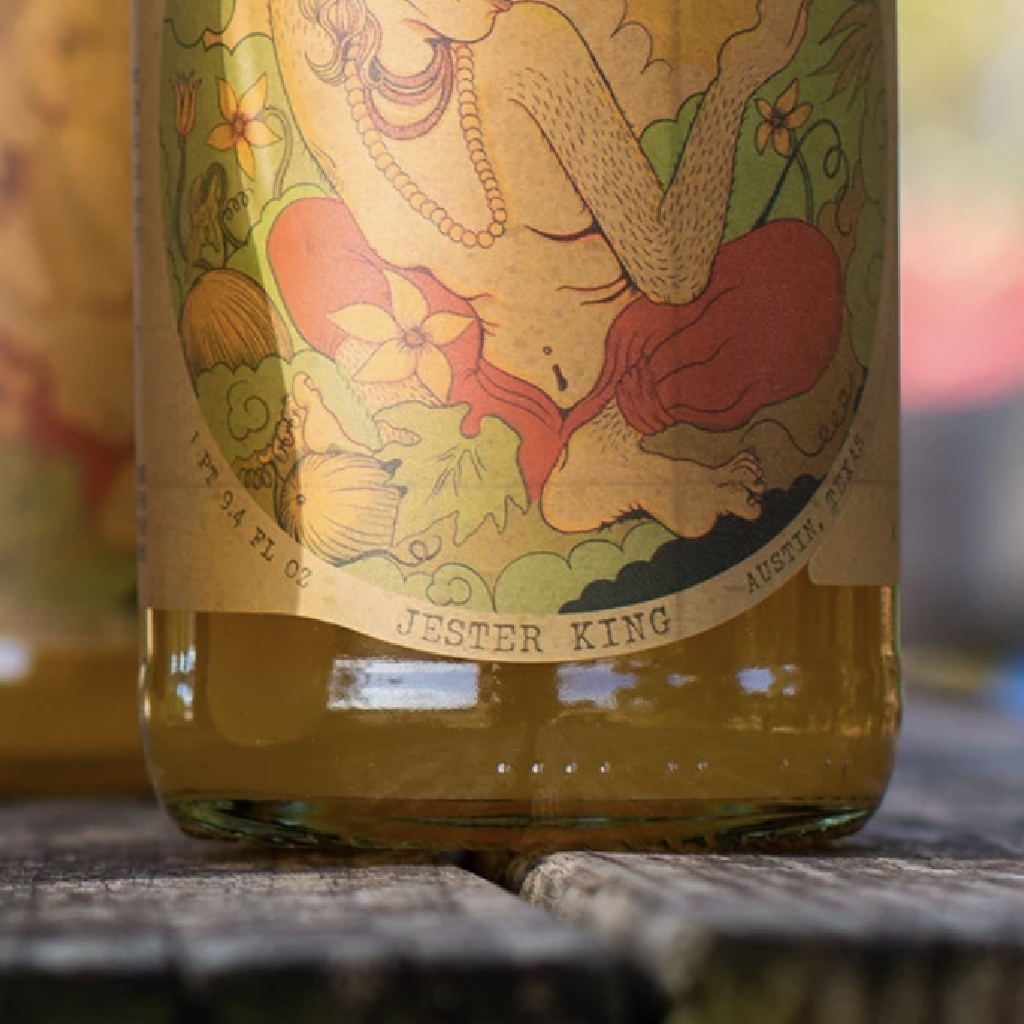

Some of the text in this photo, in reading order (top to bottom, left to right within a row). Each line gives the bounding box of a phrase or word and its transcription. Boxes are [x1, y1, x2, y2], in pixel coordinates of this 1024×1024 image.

[199, 449, 219, 486] PT
[220, 490, 246, 528] 9.4
[250, 526, 275, 562] FL
[285, 559, 313, 589] OZ
[746, 431, 865, 594] AUSTIN, TEXAS
[397, 605, 672, 653] JESTER KING
